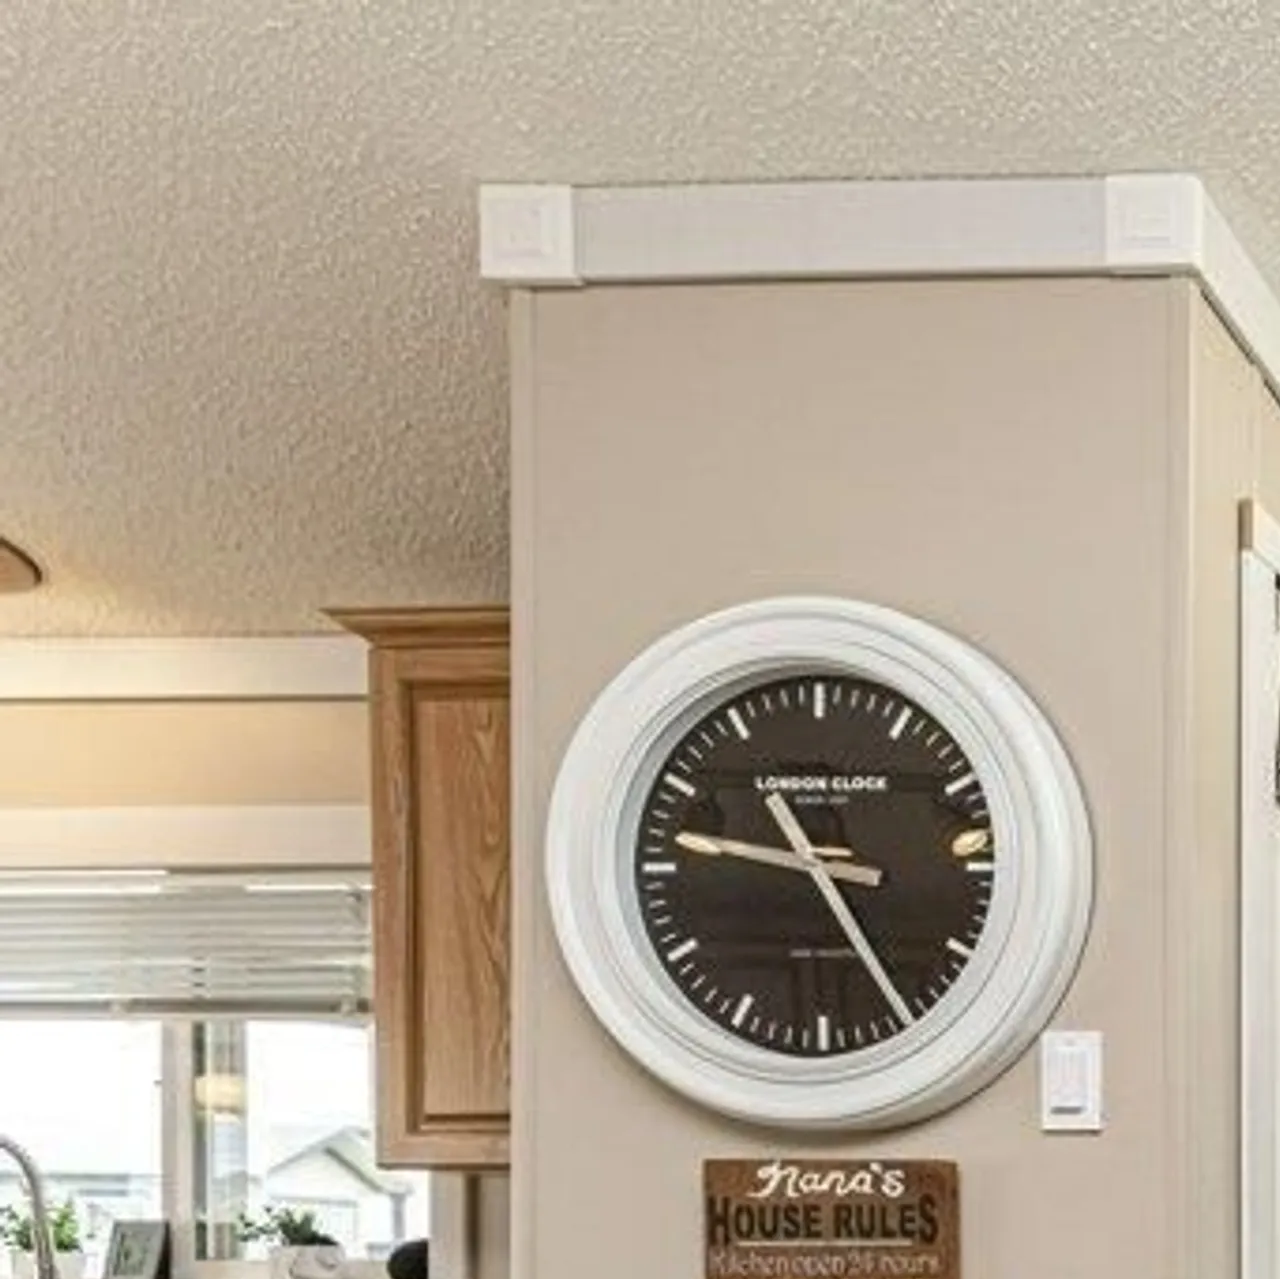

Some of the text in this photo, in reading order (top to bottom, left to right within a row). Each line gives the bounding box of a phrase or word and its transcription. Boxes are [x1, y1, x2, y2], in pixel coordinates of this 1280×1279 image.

[753, 775, 887, 791] LONDON CLOCK
[747, 1162, 905, 1198] Nana's
[708, 1193, 938, 1246] HOUSE RULES
